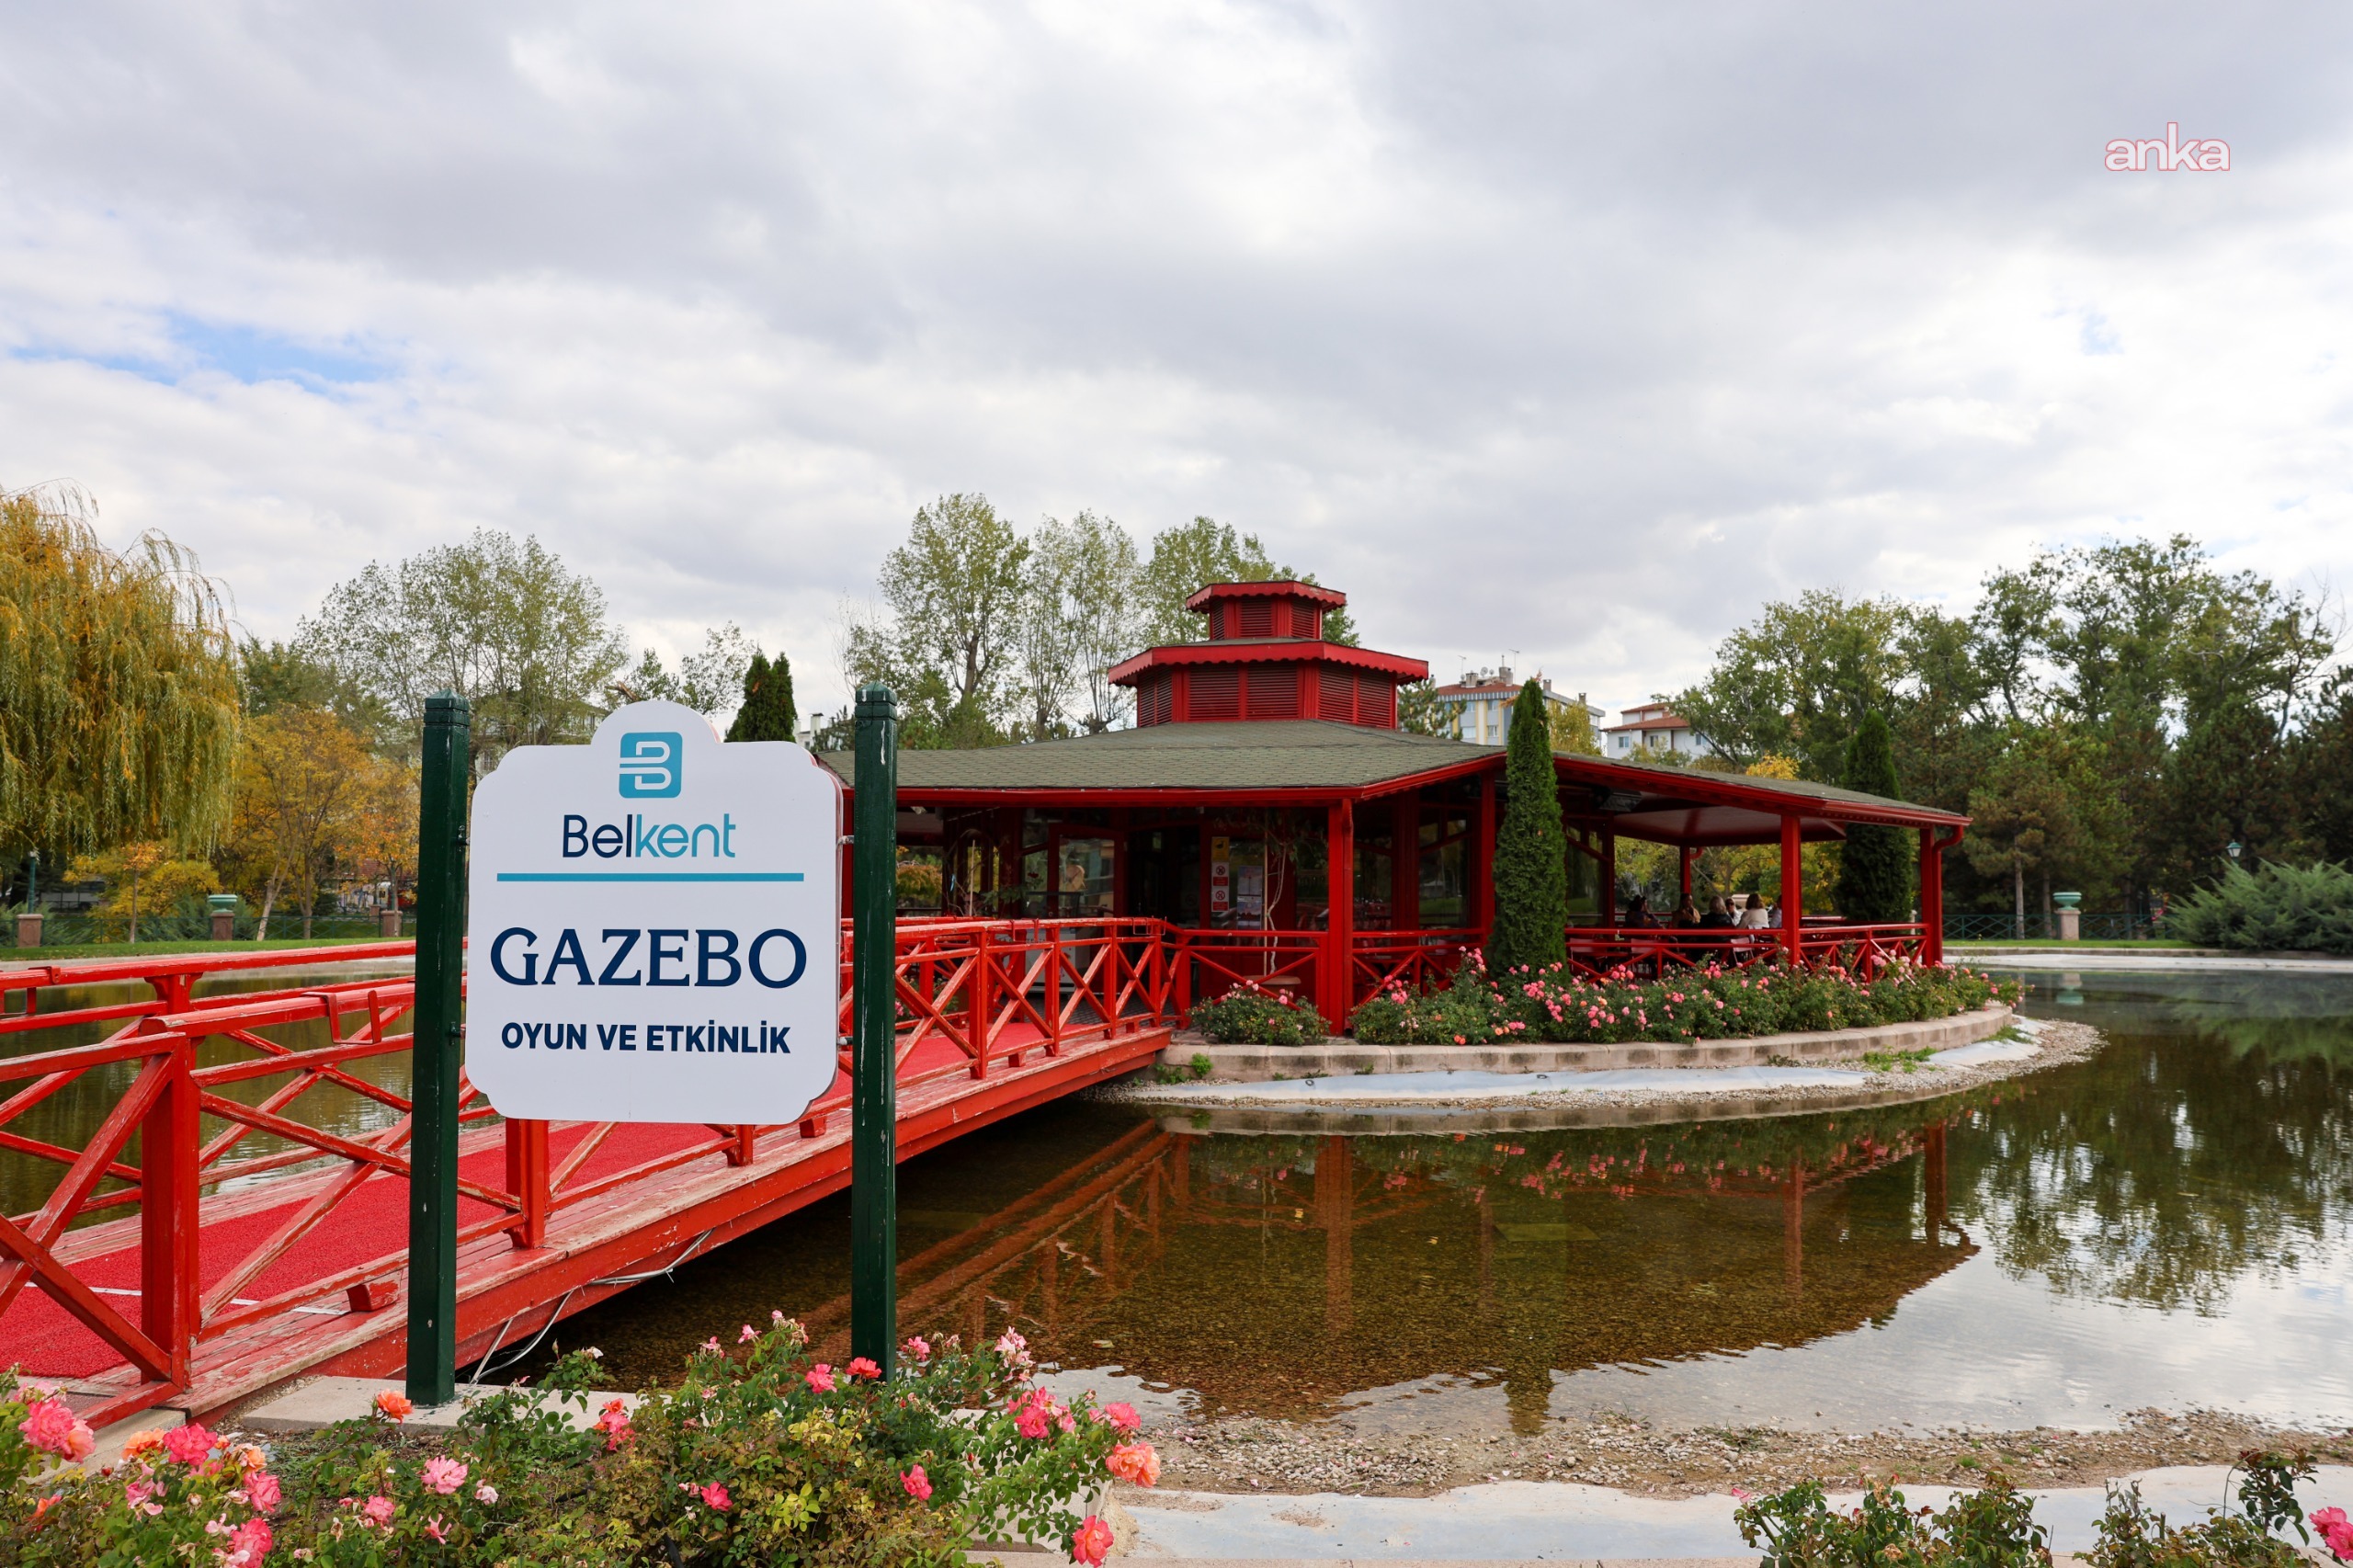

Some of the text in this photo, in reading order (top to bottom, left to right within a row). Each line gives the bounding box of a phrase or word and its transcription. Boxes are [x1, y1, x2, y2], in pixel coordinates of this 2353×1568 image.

[563, 813, 736, 858] Belkent
[491, 927, 807, 989] GAZEBO
[501, 1020, 791, 1054] OYUN VE ETKİNLİK
